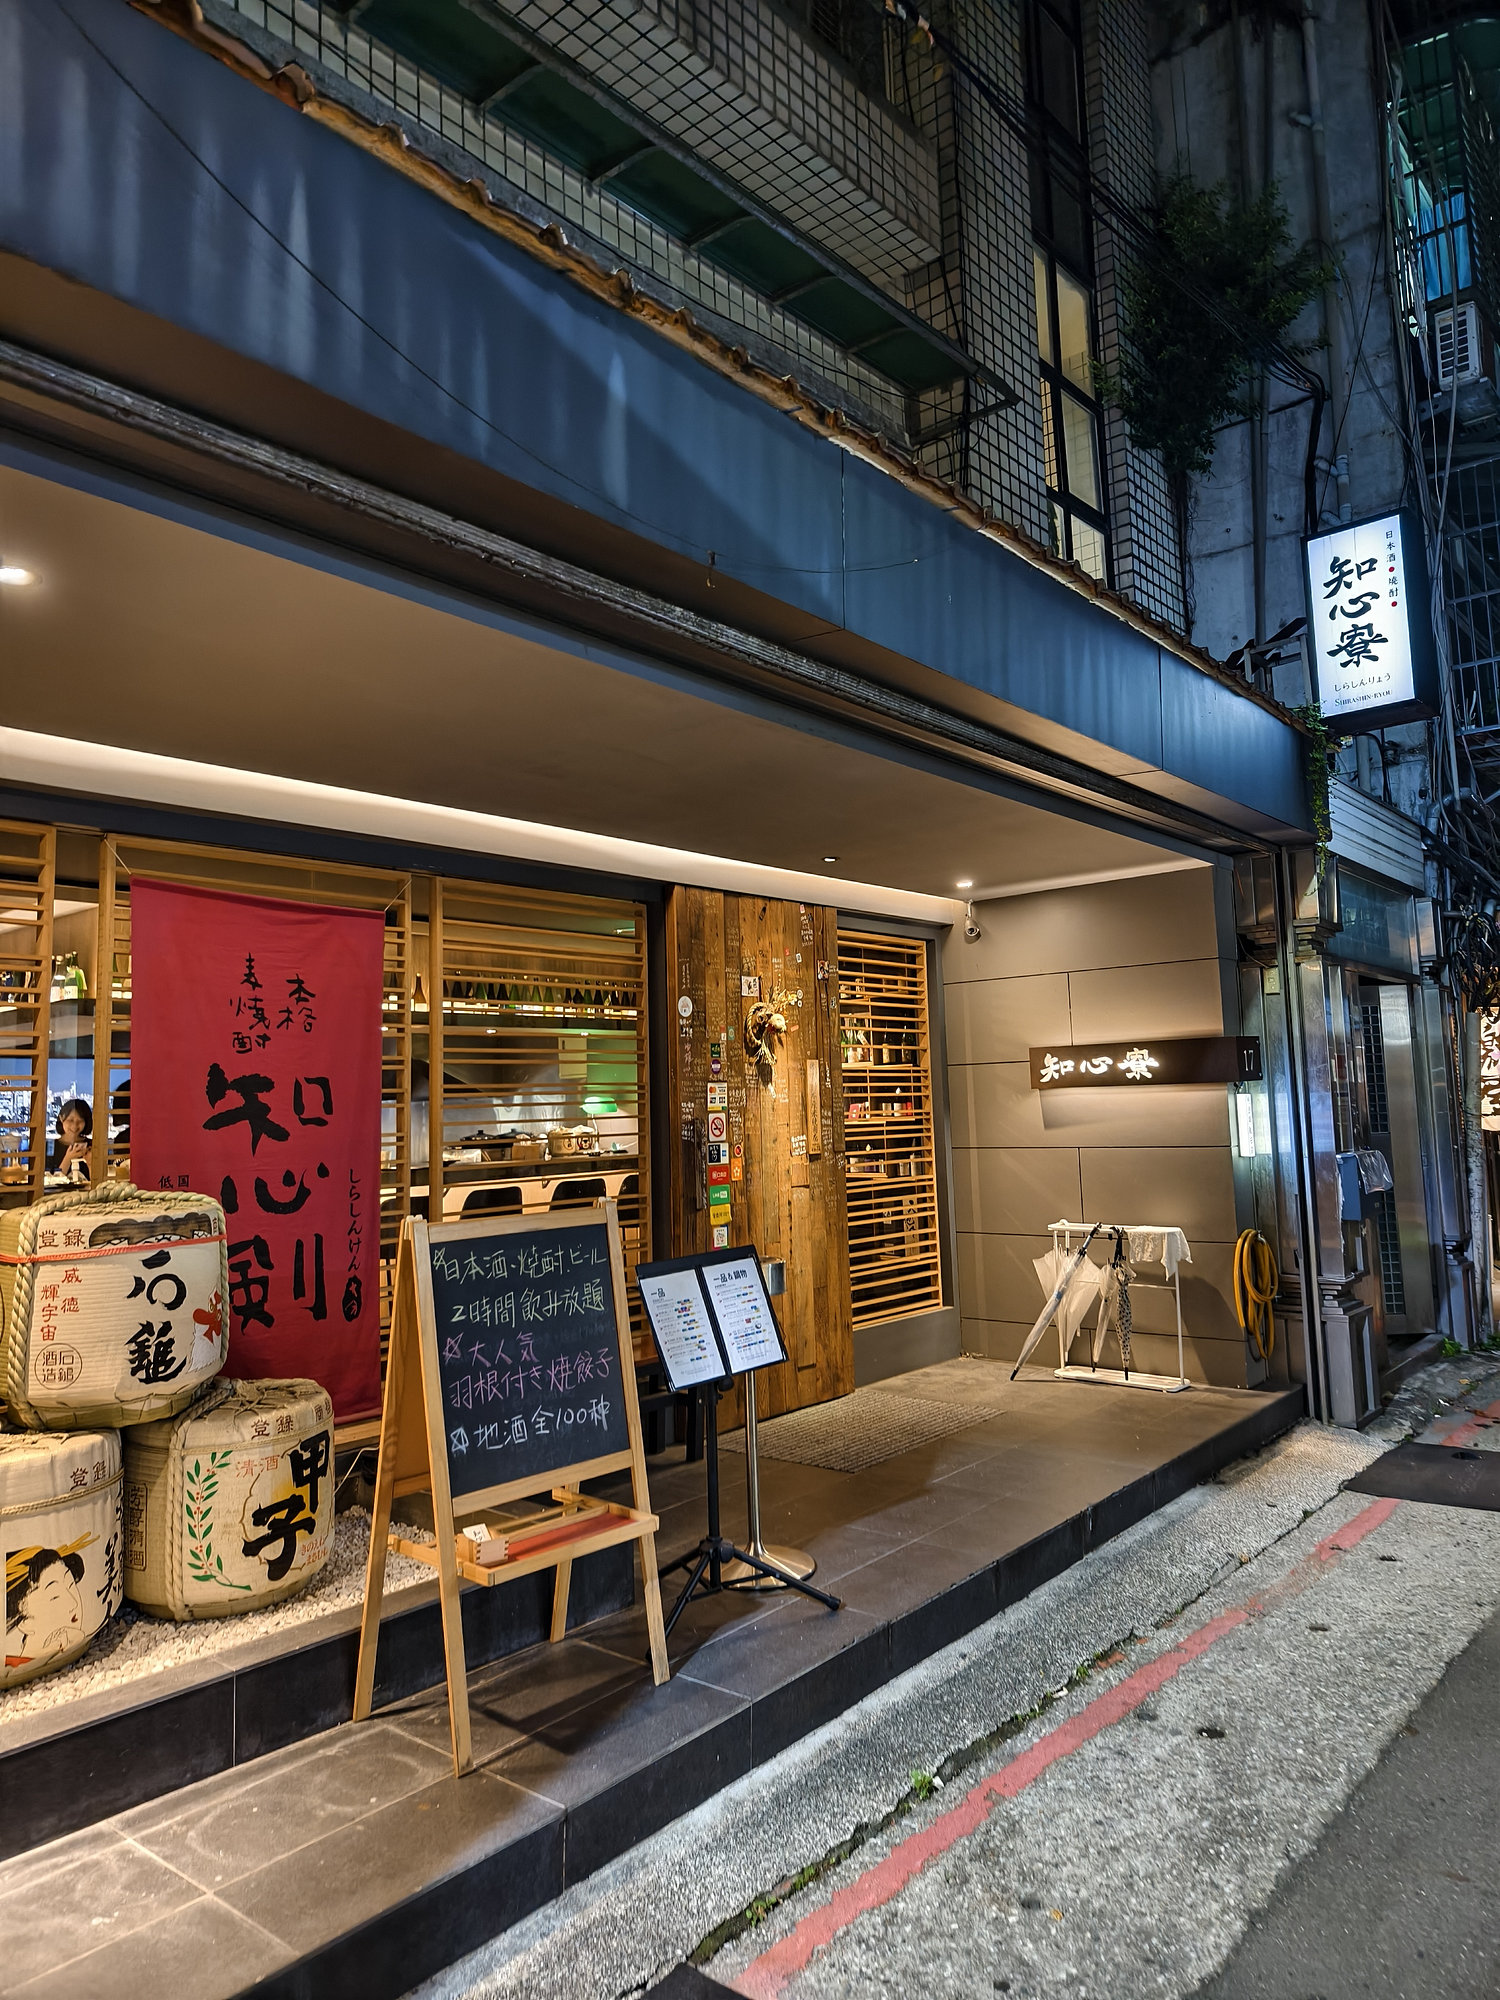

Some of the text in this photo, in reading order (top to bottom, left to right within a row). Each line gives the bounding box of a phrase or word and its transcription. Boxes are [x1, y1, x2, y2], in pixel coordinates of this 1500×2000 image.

[1386, 530, 1396, 563] 日本酒
[1334, 673, 1391, 692] しらしんりょう
[277, 973, 316, 1033] 本格
[347, 1168, 363, 1272] しらしんけん
[40, 1284, 60, 1341] 輝宇宙
[468, 1331, 540, 1368] 大人気
[251, 1415, 294, 1440] 登録
[236, 1454, 280, 1478] 清酒
[242, 1429, 330, 1581] 甲子
